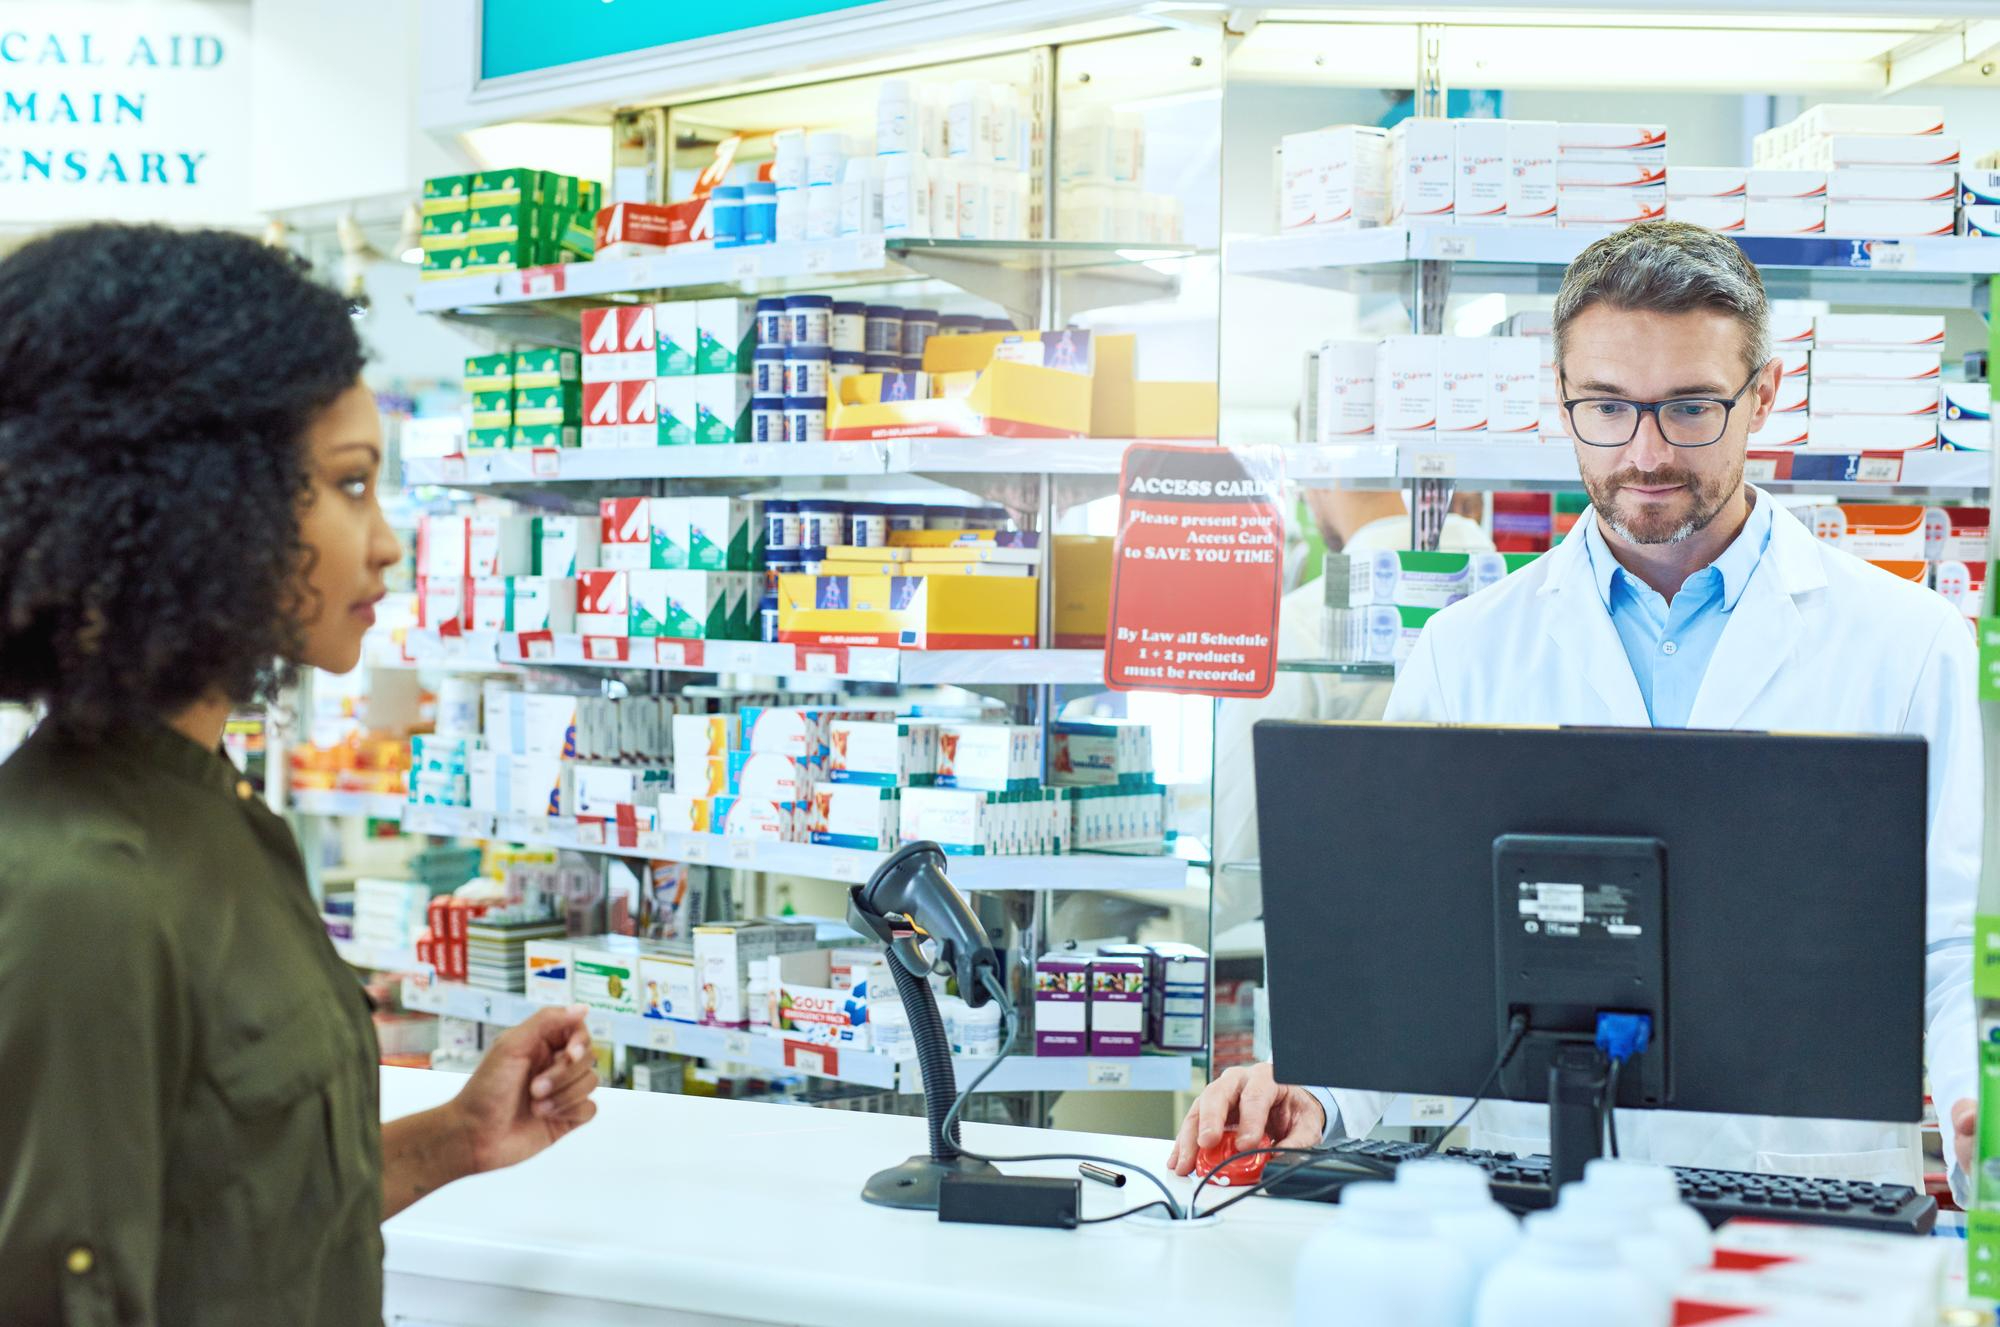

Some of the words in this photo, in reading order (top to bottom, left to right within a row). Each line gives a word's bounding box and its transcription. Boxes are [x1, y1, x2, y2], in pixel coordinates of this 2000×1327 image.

[0, 31, 104, 64] CAL
[127, 34, 224, 66] AID
[2, 91, 147, 123] MAIN
[1129, 476, 1212, 497] ACCESS
[1130, 509, 1178, 525] Please
[1181, 514, 1238, 528] present
[1240, 515, 1273, 529] your
[1186, 530, 1235, 544] Access
[1238, 531, 1273, 545] Card
[1124, 547, 1141, 559] to
[1144, 546, 1191, 561] SAVE
[1195, 547, 1231, 563] YOU
[1234, 549, 1274, 563] TIME
[1117, 626, 1138, 643] By
[1141, 628, 1174, 643] Law
[1177, 631, 1198, 645] all
[1200, 632, 1269, 647] Schedule
[1139, 648, 1148, 660] 1
[1152, 650, 1160, 658] +
[1164, 650, 1174, 661] 2
[1176, 651, 1246, 664] products
[1124, 665, 1164, 678] must
[1167, 665, 1185, 679] be
[1187, 669, 1257, 683] recorded
[793, 996, 834, 1011] GOUT
